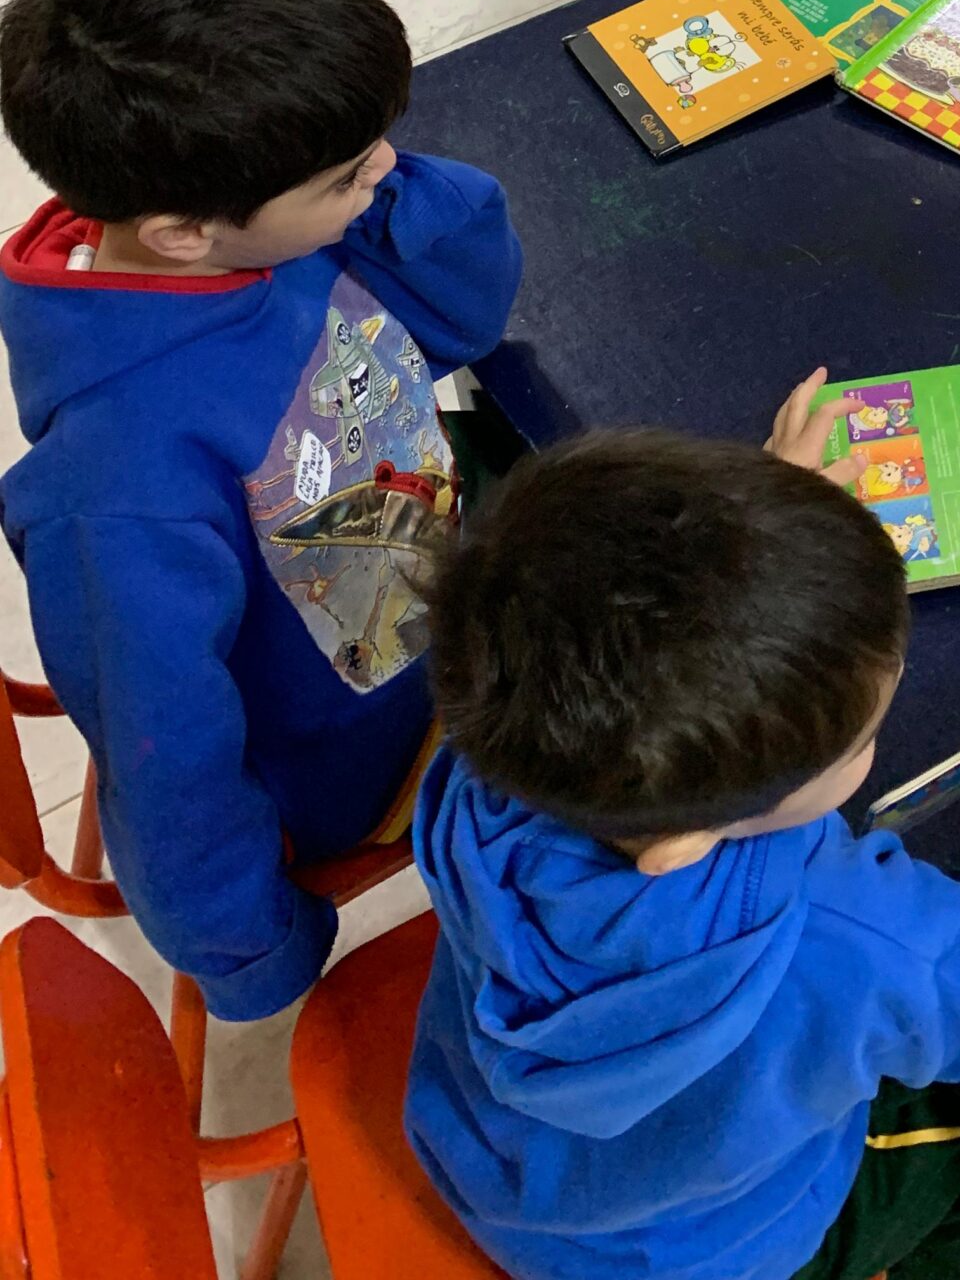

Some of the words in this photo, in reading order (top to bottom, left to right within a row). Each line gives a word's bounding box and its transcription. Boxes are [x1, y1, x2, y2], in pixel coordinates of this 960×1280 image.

[737, 11, 757, 26] mi
[751, 23, 777, 47] bebé
[778, 25, 805, 52] serás
